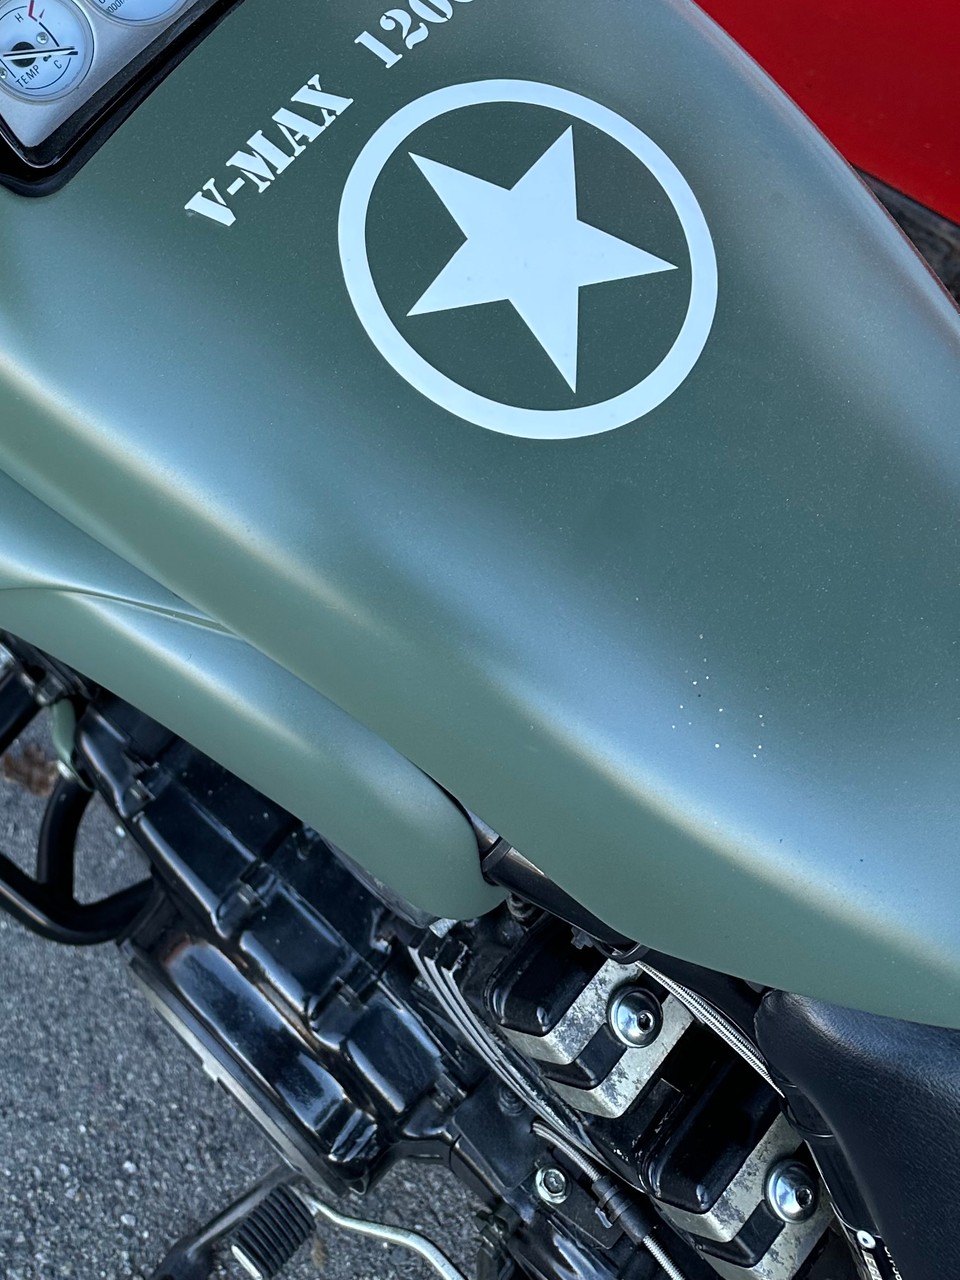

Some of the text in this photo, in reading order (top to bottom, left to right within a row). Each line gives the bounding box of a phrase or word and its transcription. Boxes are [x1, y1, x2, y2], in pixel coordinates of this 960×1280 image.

[14, 12, 24, 23] H
[53, 59, 62, 70] C
[15, 64, 40, 88] TEMP
[183, 73, 354, 227] V-MAX
